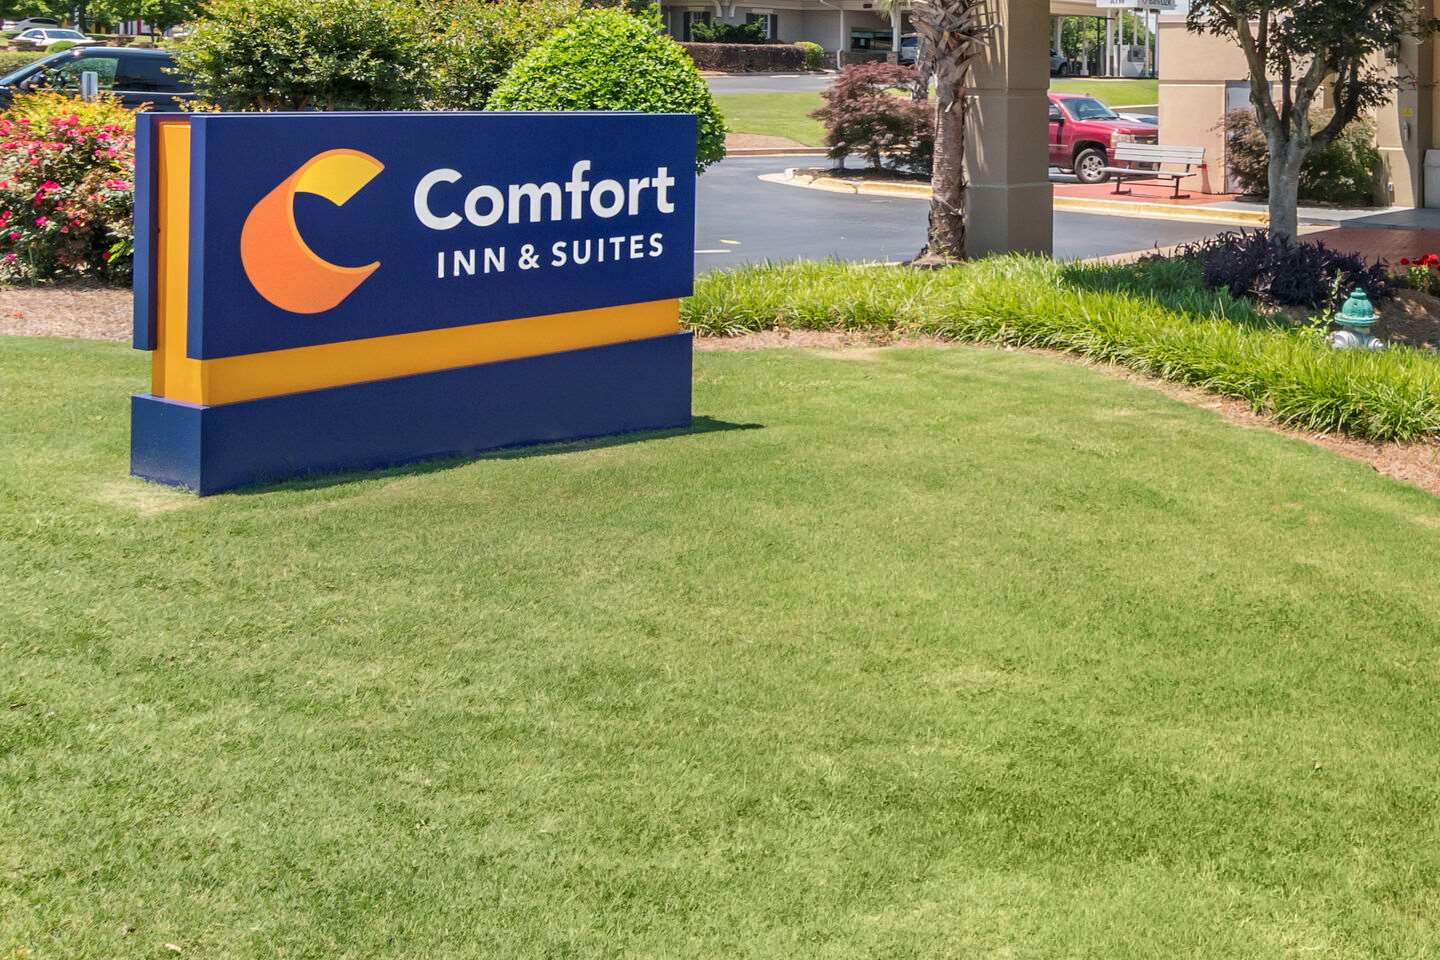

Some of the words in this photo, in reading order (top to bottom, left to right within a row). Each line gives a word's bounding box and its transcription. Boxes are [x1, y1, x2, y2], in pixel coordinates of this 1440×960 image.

[413, 159, 676, 231] Comfort
[437, 246, 506, 279] INN
[518, 243, 540, 270] &
[551, 232, 664, 268] SUITES
